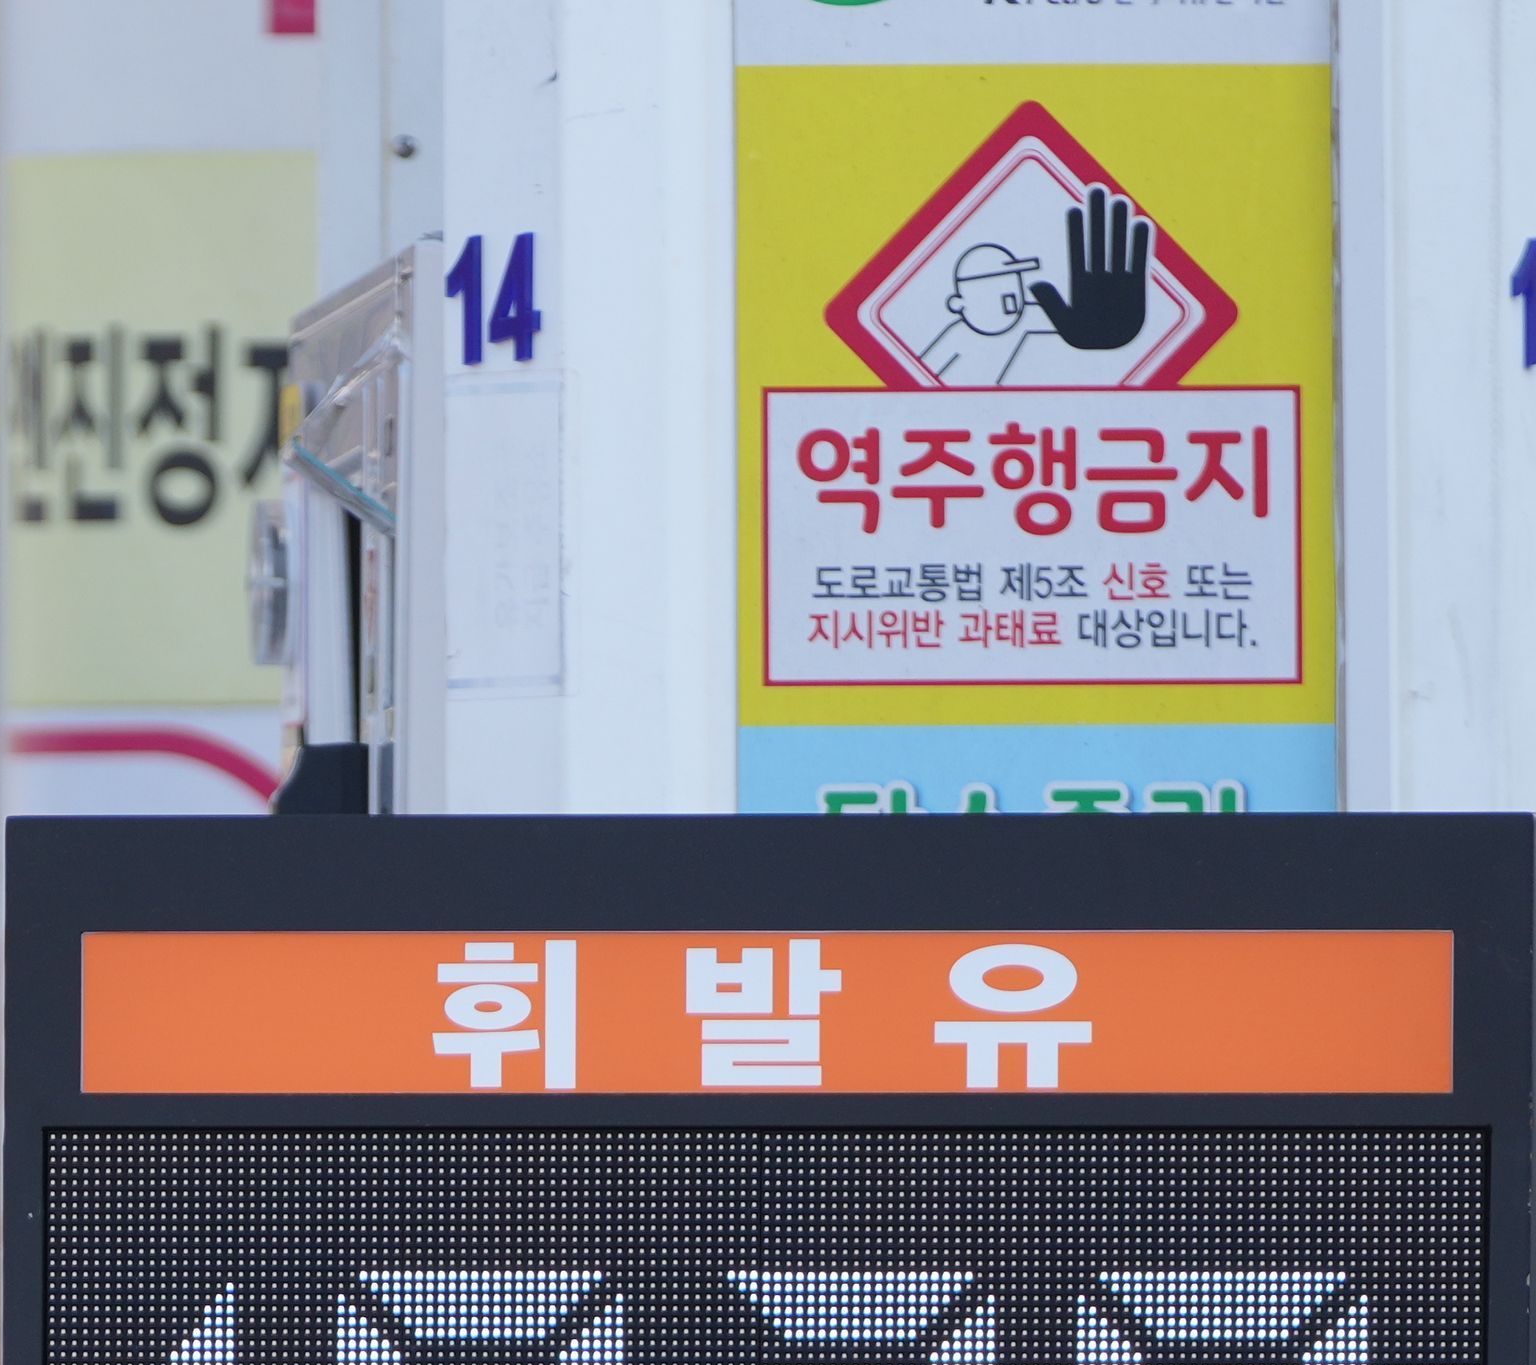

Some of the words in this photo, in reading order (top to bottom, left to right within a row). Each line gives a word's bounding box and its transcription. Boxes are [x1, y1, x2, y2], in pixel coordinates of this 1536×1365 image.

[444, 231, 542, 366] 14
[796, 422, 1270, 537] 역주행금지
[811, 562, 983, 603] 도로교통법
[999, 562, 1089, 602] 제5조
[1102, 562, 1170, 602] 신호
[1183, 562, 1254, 602] 또는
[808, 609, 945, 650] 지시위반
[958, 609, 1063, 649] 과태료
[1077, 609, 1259, 650] 대상입니다.
